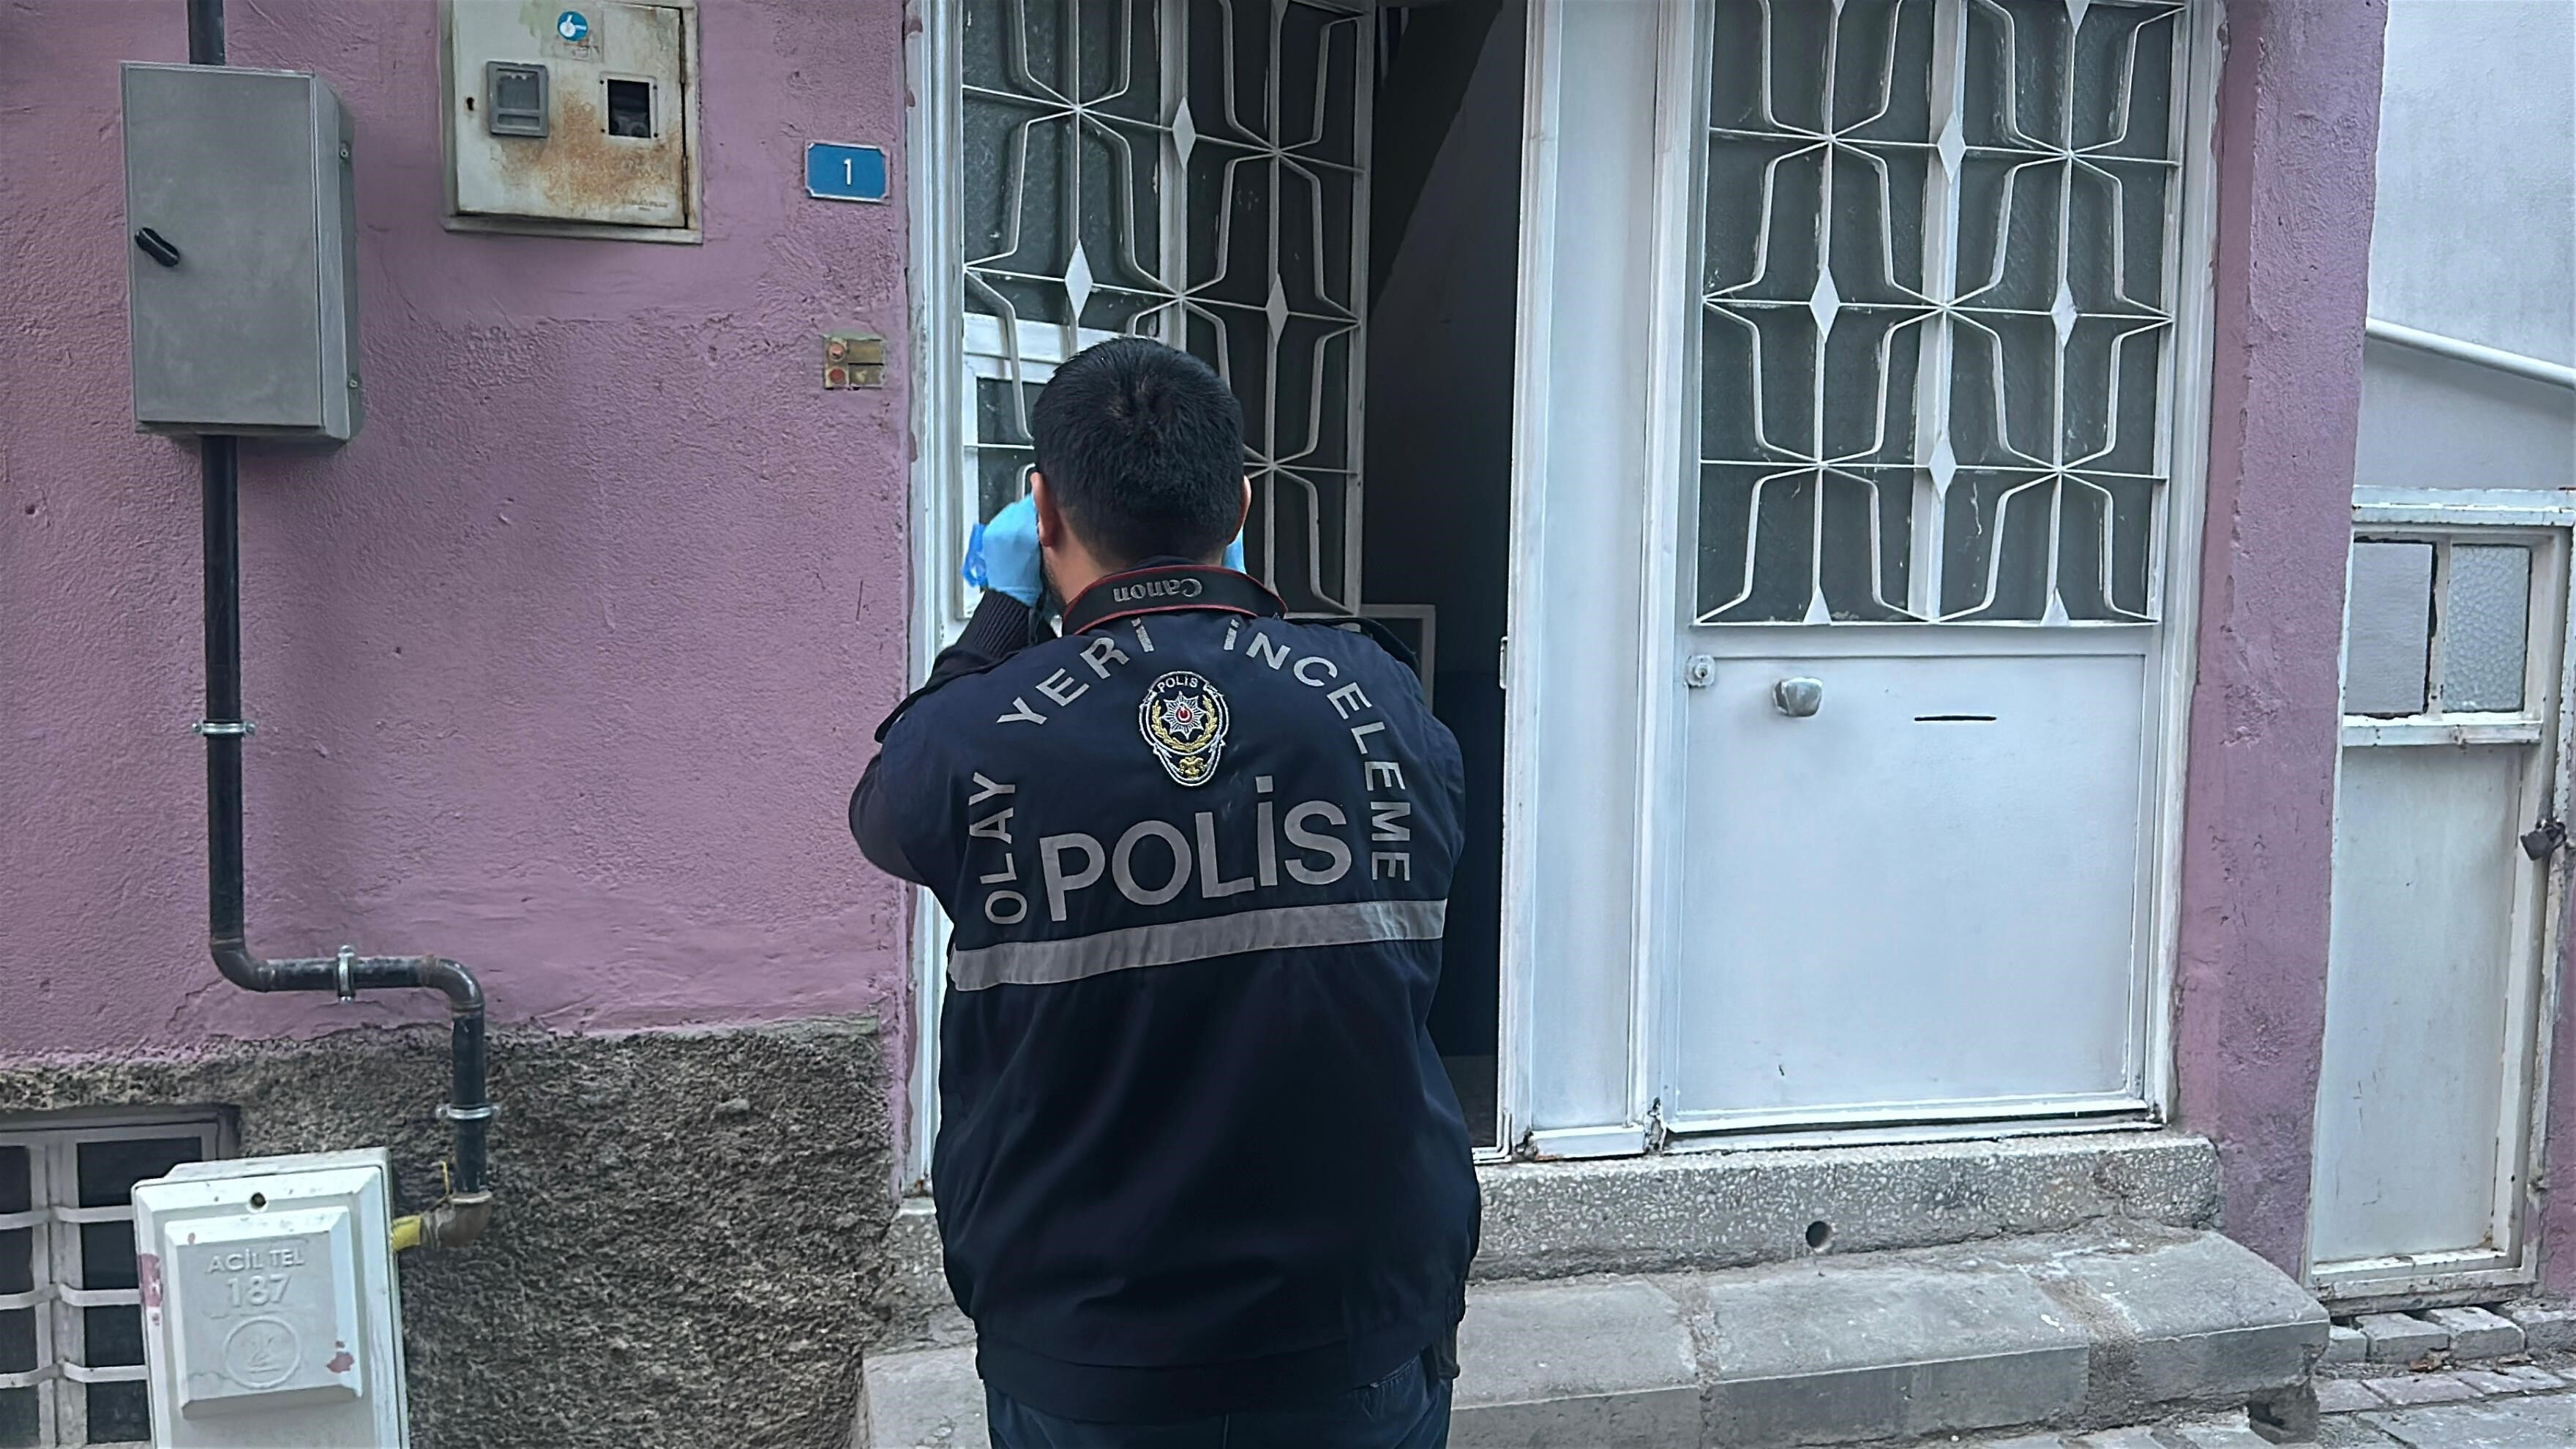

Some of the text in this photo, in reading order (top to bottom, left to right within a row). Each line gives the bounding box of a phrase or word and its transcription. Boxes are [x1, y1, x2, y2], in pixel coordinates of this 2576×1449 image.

[844, 157, 852, 186] 1
[1113, 577, 1202, 603] Canon
[1156, 675, 1199, 693] POLİS
[969, 619, 1411, 925] OLAY YERİ İNCELEME
[1039, 776, 1352, 922] POLİS
[205, 1248, 305, 1273] ACİL TEL
[226, 1273, 292, 1308] 187
